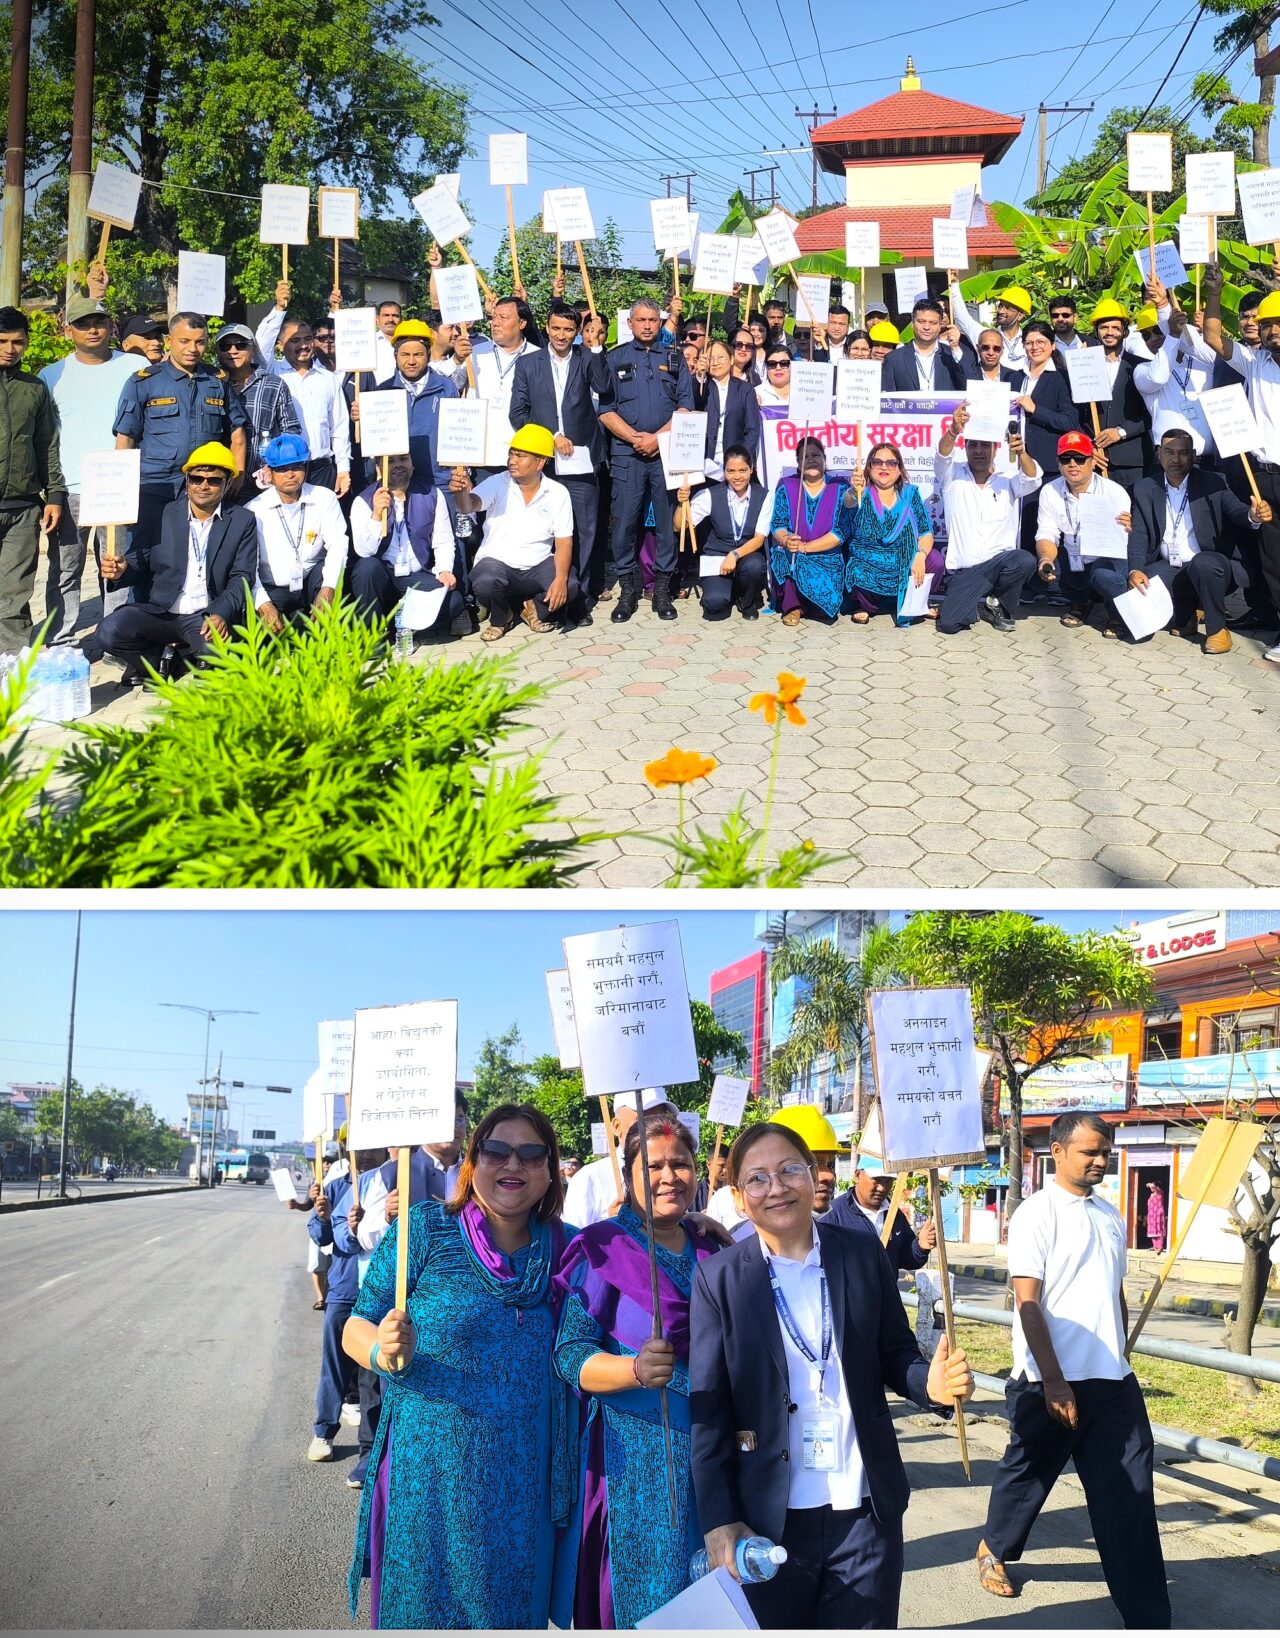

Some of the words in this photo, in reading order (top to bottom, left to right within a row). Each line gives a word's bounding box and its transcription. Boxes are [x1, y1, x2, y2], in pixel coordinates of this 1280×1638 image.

[1146, 944, 1158, 959] &
[1160, 929, 1216, 957] LODGE
[586, 952, 624, 970] समयमै
[627, 950, 665, 966] महसुल
[594, 974, 634, 995] भुक्तानी
[904, 1017, 948, 1030] अनलाइन
[890, 1042, 924, 1058] महशुल
[928, 1037, 962, 1056] भुक्तानी
[897, 1087, 936, 1104] समयको
[922, 1112, 942, 1126] गरौं
